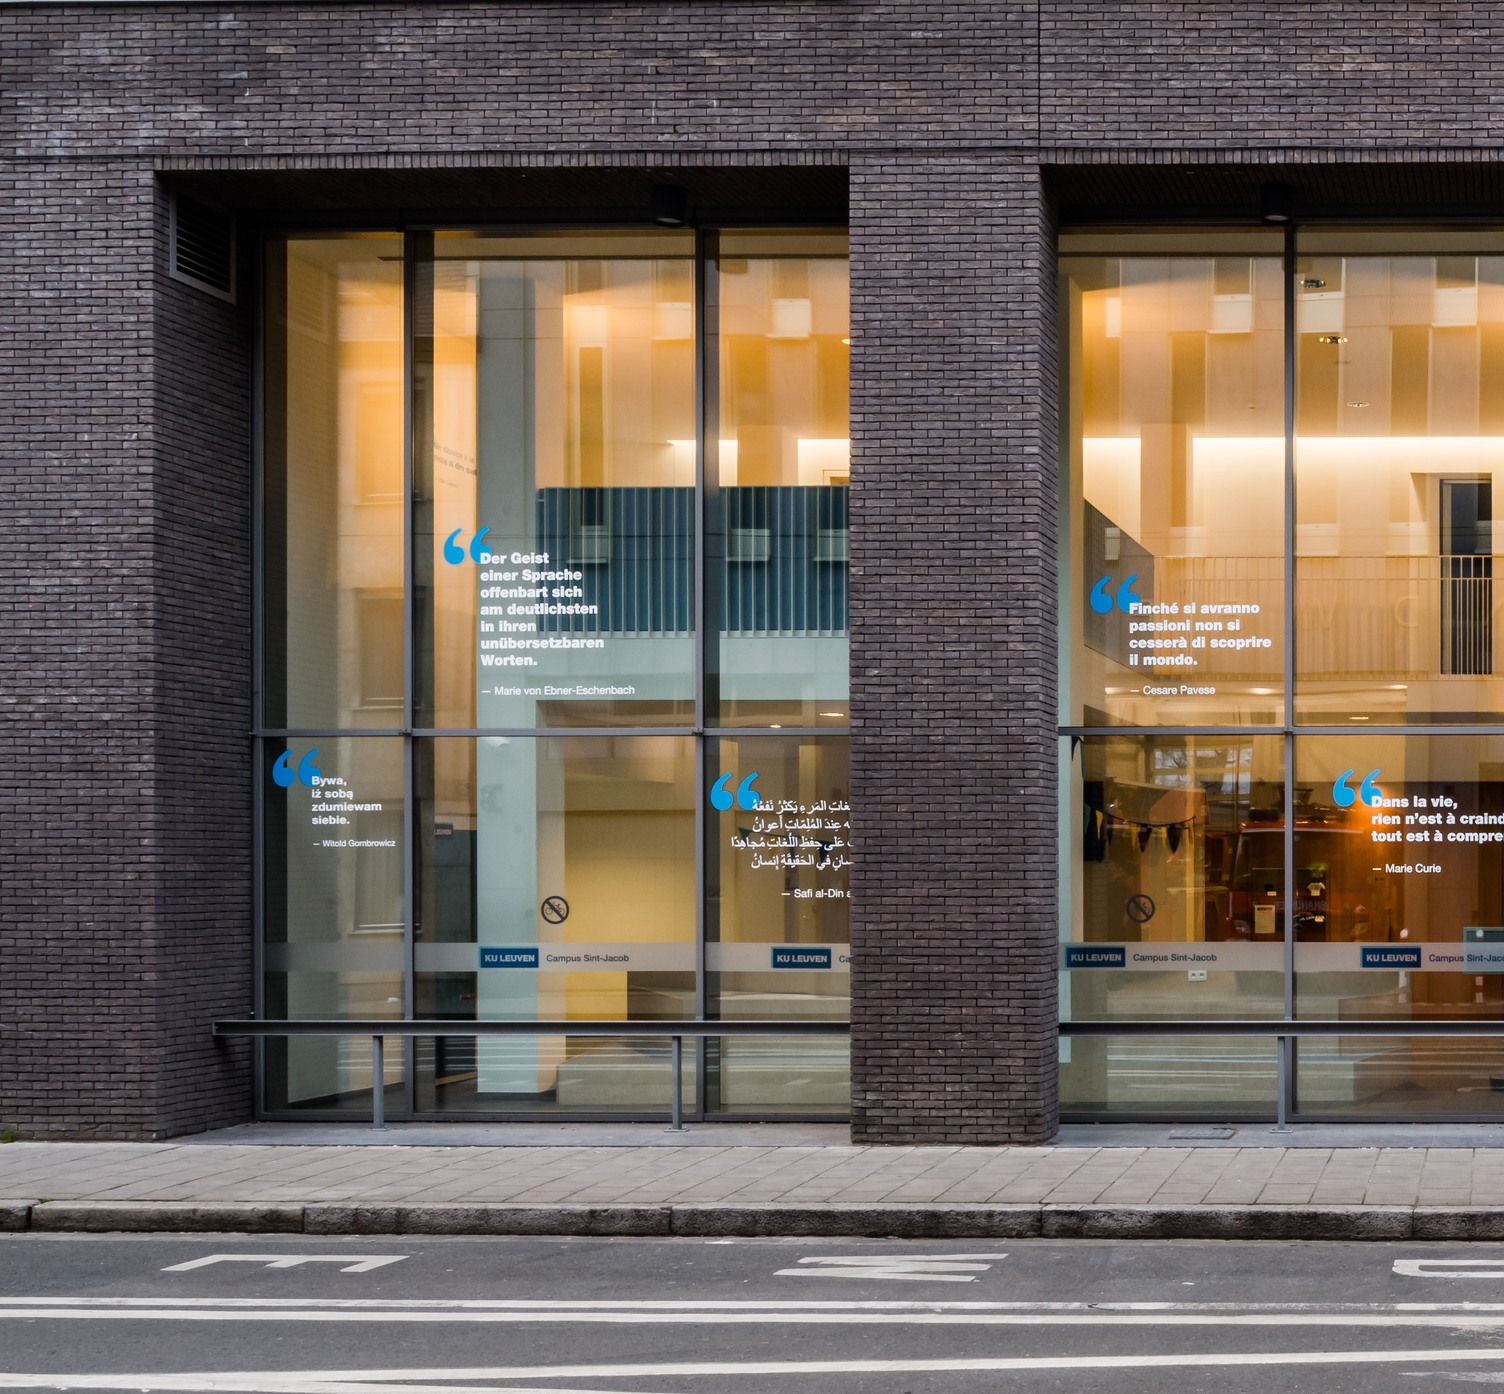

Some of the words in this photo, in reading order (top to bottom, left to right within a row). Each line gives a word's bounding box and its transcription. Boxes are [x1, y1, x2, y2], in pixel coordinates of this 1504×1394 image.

[480, 552, 507, 564] Der
[510, 552, 550, 564] Geist
[480, 570, 518, 581] einer
[522, 569, 583, 583] Sprache
[480, 586, 548, 598] offenbart
[551, 586, 583, 598] sich
[480, 605, 503, 615] am
[506, 603, 598, 615] deutlichsten
[1129, 602, 1179, 615] Finché
[1183, 602, 1196, 614] si
[1200, 604, 1260, 614] avranno
[480, 620, 494, 632] in
[498, 620, 537, 632] ihren
[1129, 619, 1190, 634] passioni
[1195, 621, 1223, 631] non
[1227, 619, 1240, 631] si
[480, 637, 604, 649] unübersetzbaren
[1129, 636, 1187, 648] cesserà
[1191, 636, 1206, 648] di
[1210, 636, 1272, 650] scoprire
[480, 654, 538, 666] Worten.
[1129, 654, 1139, 666] il
[1143, 654, 1198, 666] mondo.
[494, 686, 521, 696] Marie
[544, 685, 635, 695] Ebner-Eschenbach
[1143, 685, 1178, 695] Cesare
[1180, 685, 1216, 695] Pavese
[311, 776, 347, 787] Bywa,
[311, 789, 322, 798] iż
[324, 789, 354, 800] sobą
[311, 802, 382, 812] zdumiewam
[1371, 795, 1409, 808] Dans
[1413, 795, 1427, 808] la
[1431, 795, 1458, 810] vie,
[311, 815, 350, 825] siebie.
[1371, 813, 1401, 825] rien
[1446, 812, 1456, 825] à
[1371, 831, 1402, 842] tout
[1406, 831, 1430, 842] est
[1433, 830, 1443, 842] à
[322, 839, 347, 847] Witold
[348, 839, 396, 847] Gombrowicz
[816, 855, 831, 871] في
[1385, 863, 1413, 873] Marie
[1414, 863, 1442, 873] Curie
[794, 888, 813, 898] Safi
[815, 888, 844, 898] al-Din
[546, 954, 581, 963] Campus
[583, 954, 630, 962] Sint-Jacob
[1071, 953, 1083, 961] KU
[1086, 953, 1121, 961] LEUVEN
[1133, 954, 1168, 962] Campus
[1366, 954, 1379, 962] KU
[1381, 954, 1417, 962] LEUVEN
[1429, 954, 1464, 963] Campus
